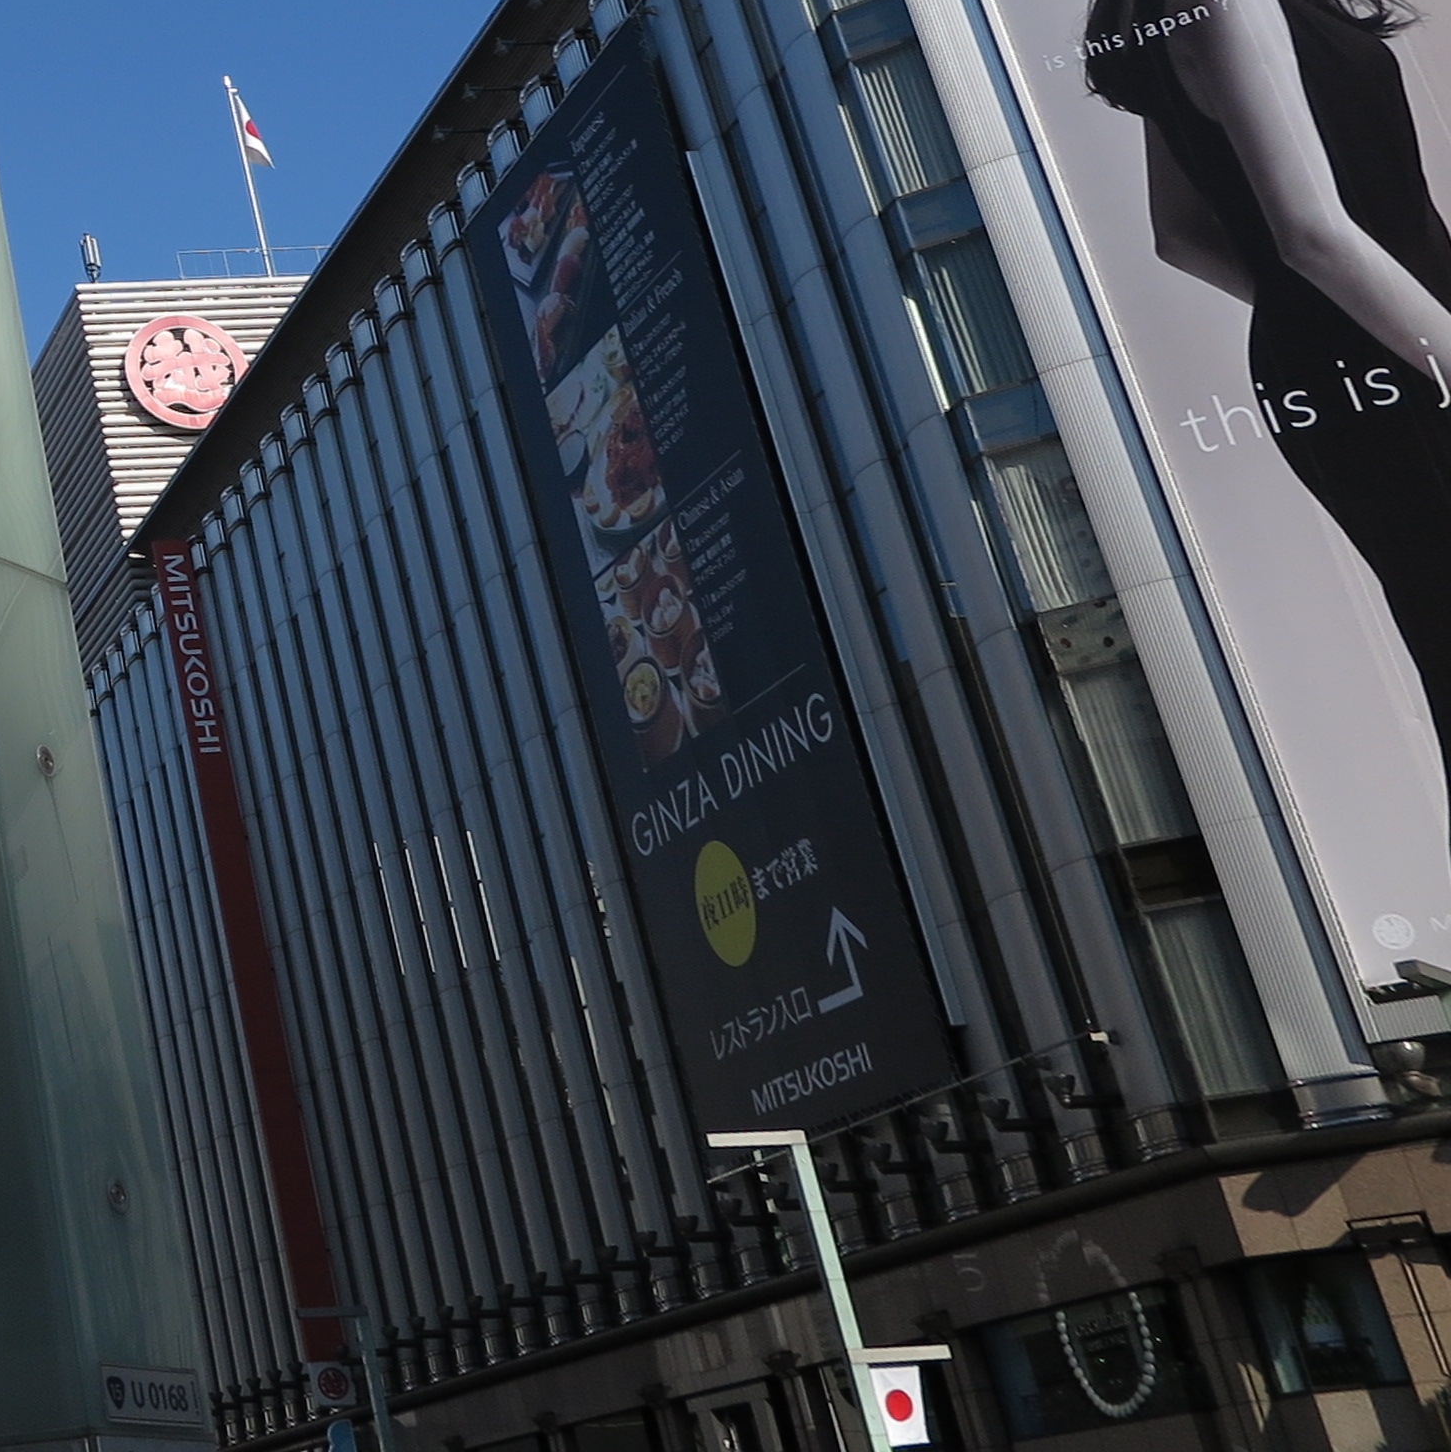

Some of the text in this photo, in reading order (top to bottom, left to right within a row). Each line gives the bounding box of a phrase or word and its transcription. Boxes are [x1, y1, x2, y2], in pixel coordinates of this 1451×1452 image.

[1043, 54, 1065, 72] is
[1073, 33, 1126, 60] this
[1132, 4, 1211, 46] japan
[1179, 382, 1318, 452] this
[1336, 359, 1401, 413] is
[162, 553, 222, 754] MITSUKOSHI
[632, 693, 833, 857] GINZA DINING
[709, 986, 814, 1061] レストラン入口
[751, 1042, 874, 1116] MITSUKOSHI
[131, 1380, 145, 1408] U
[148, 1382, 189, 1412] 0168
